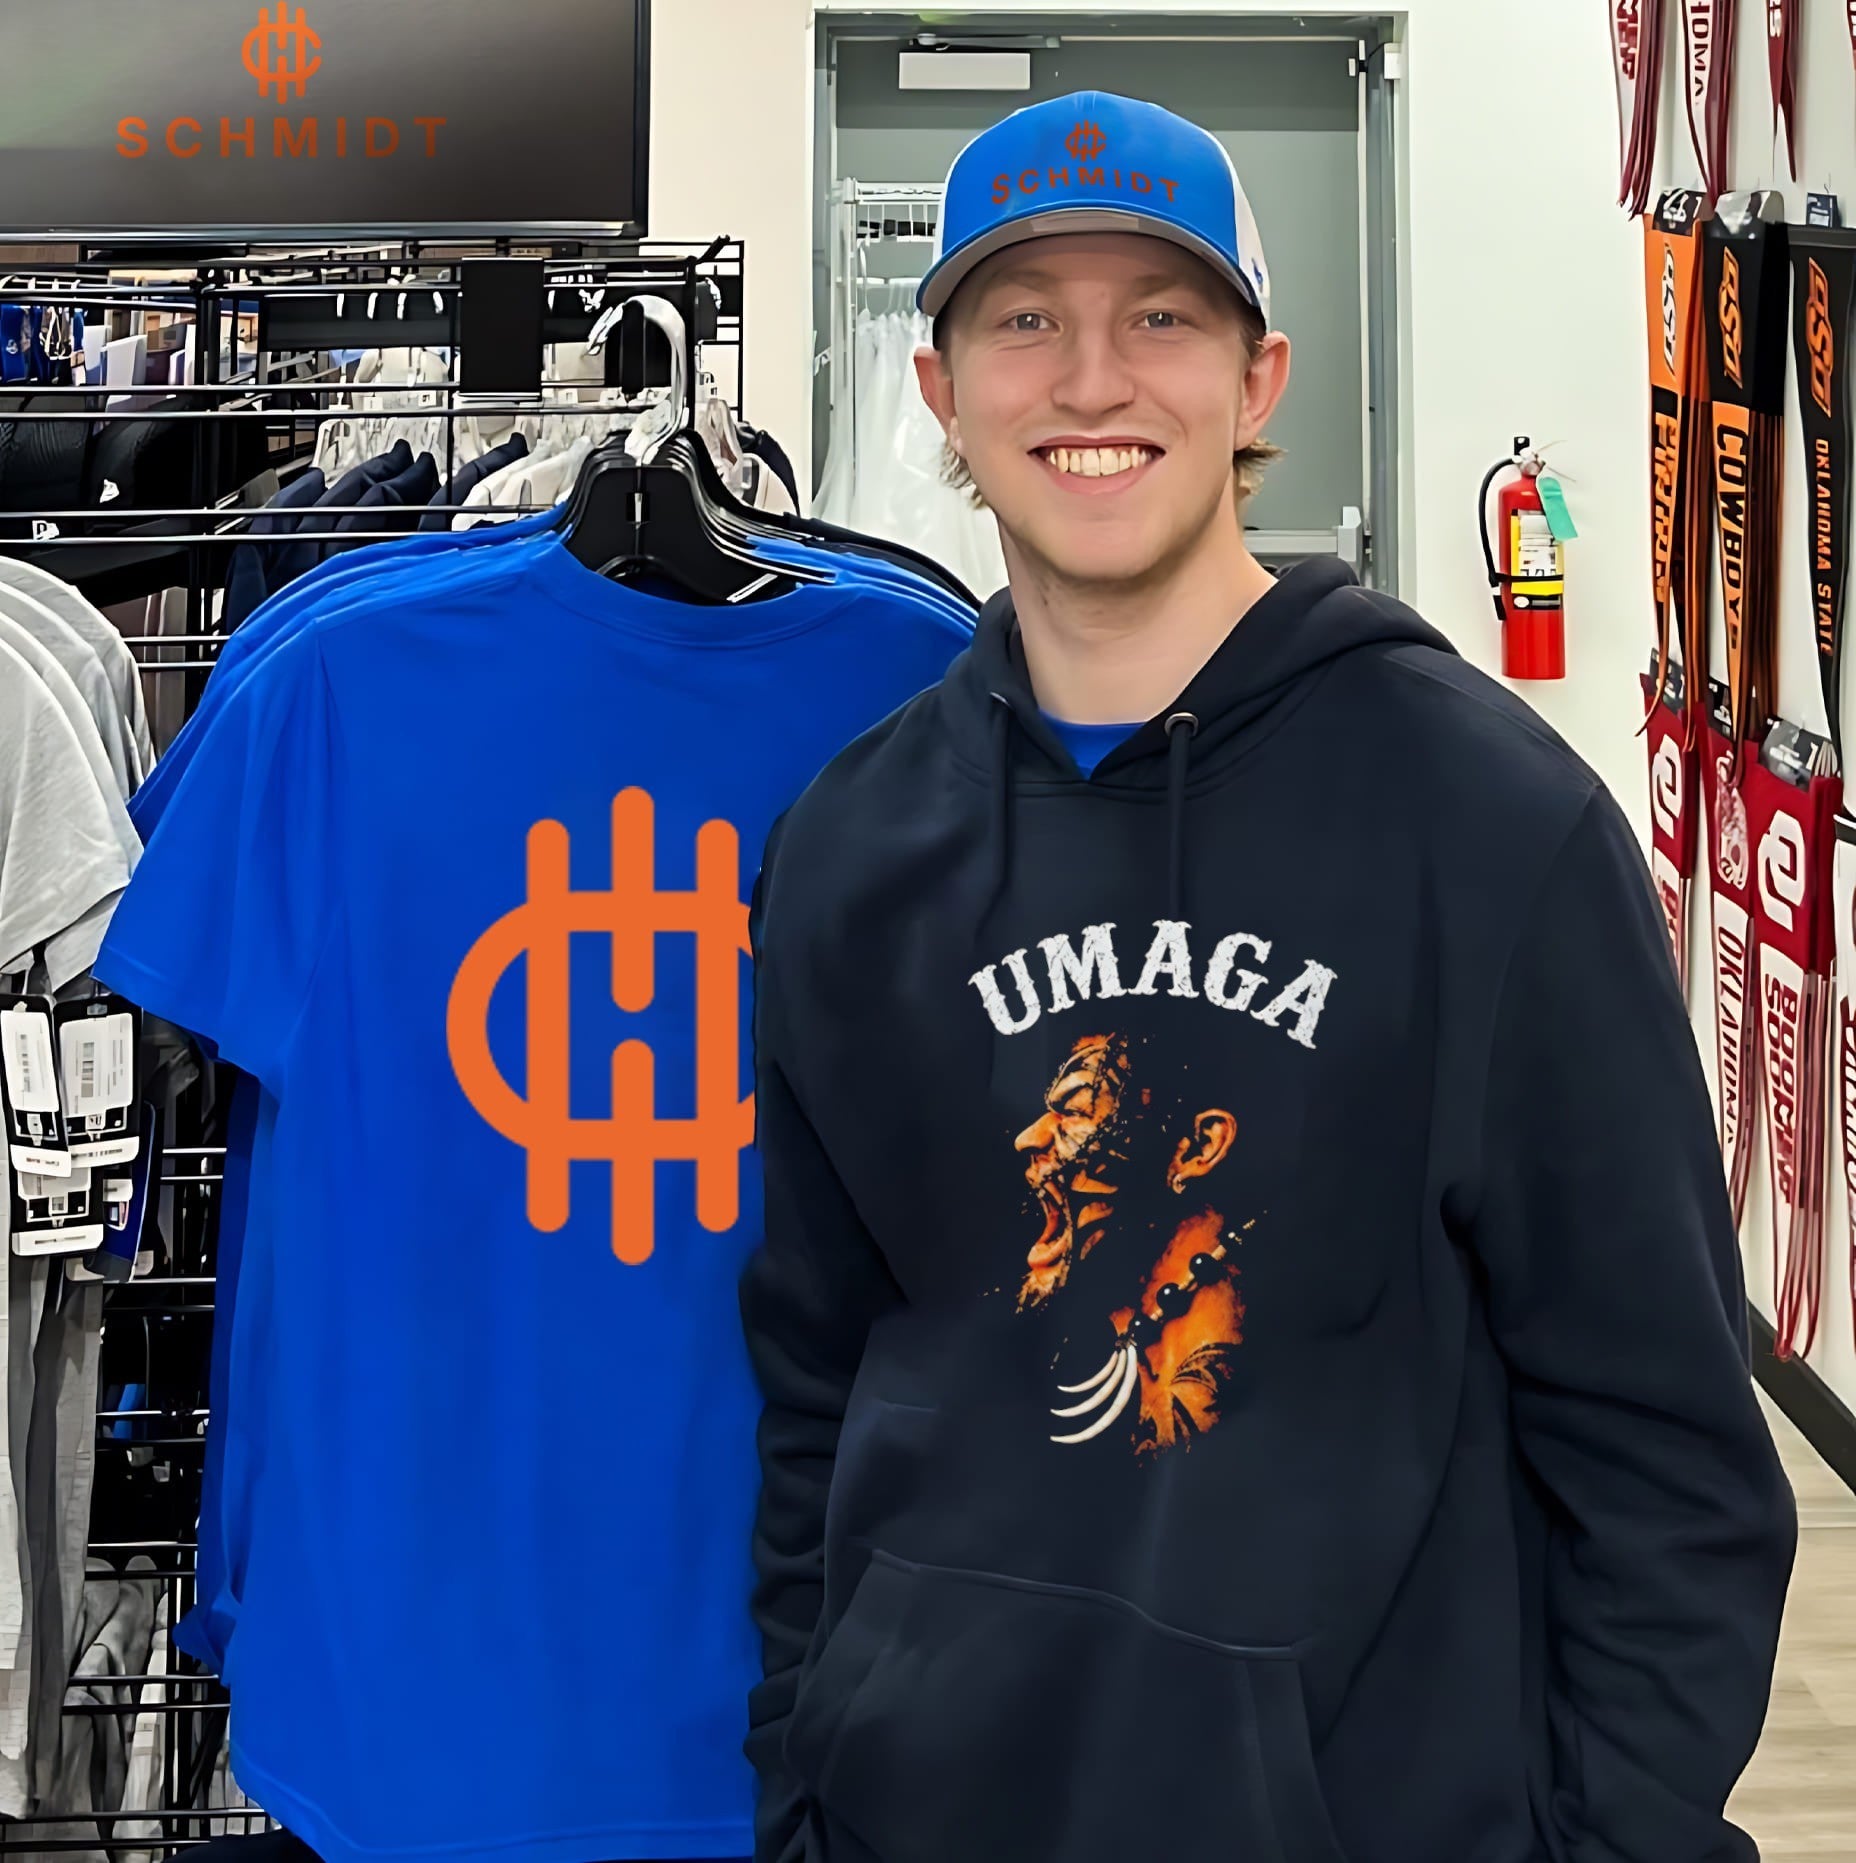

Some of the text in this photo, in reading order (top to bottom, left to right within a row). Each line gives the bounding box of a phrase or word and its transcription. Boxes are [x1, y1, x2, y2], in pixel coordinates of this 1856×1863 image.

[115, 115, 448, 159] SCHMIDT
[991, 166, 1179, 204] SCHMIDT
[1815, 439, 1833, 657] OKLAHOMA STATE
[967, 919, 1338, 1049] UMAGA
[1718, 926, 1745, 1144] OKLAHOMA
